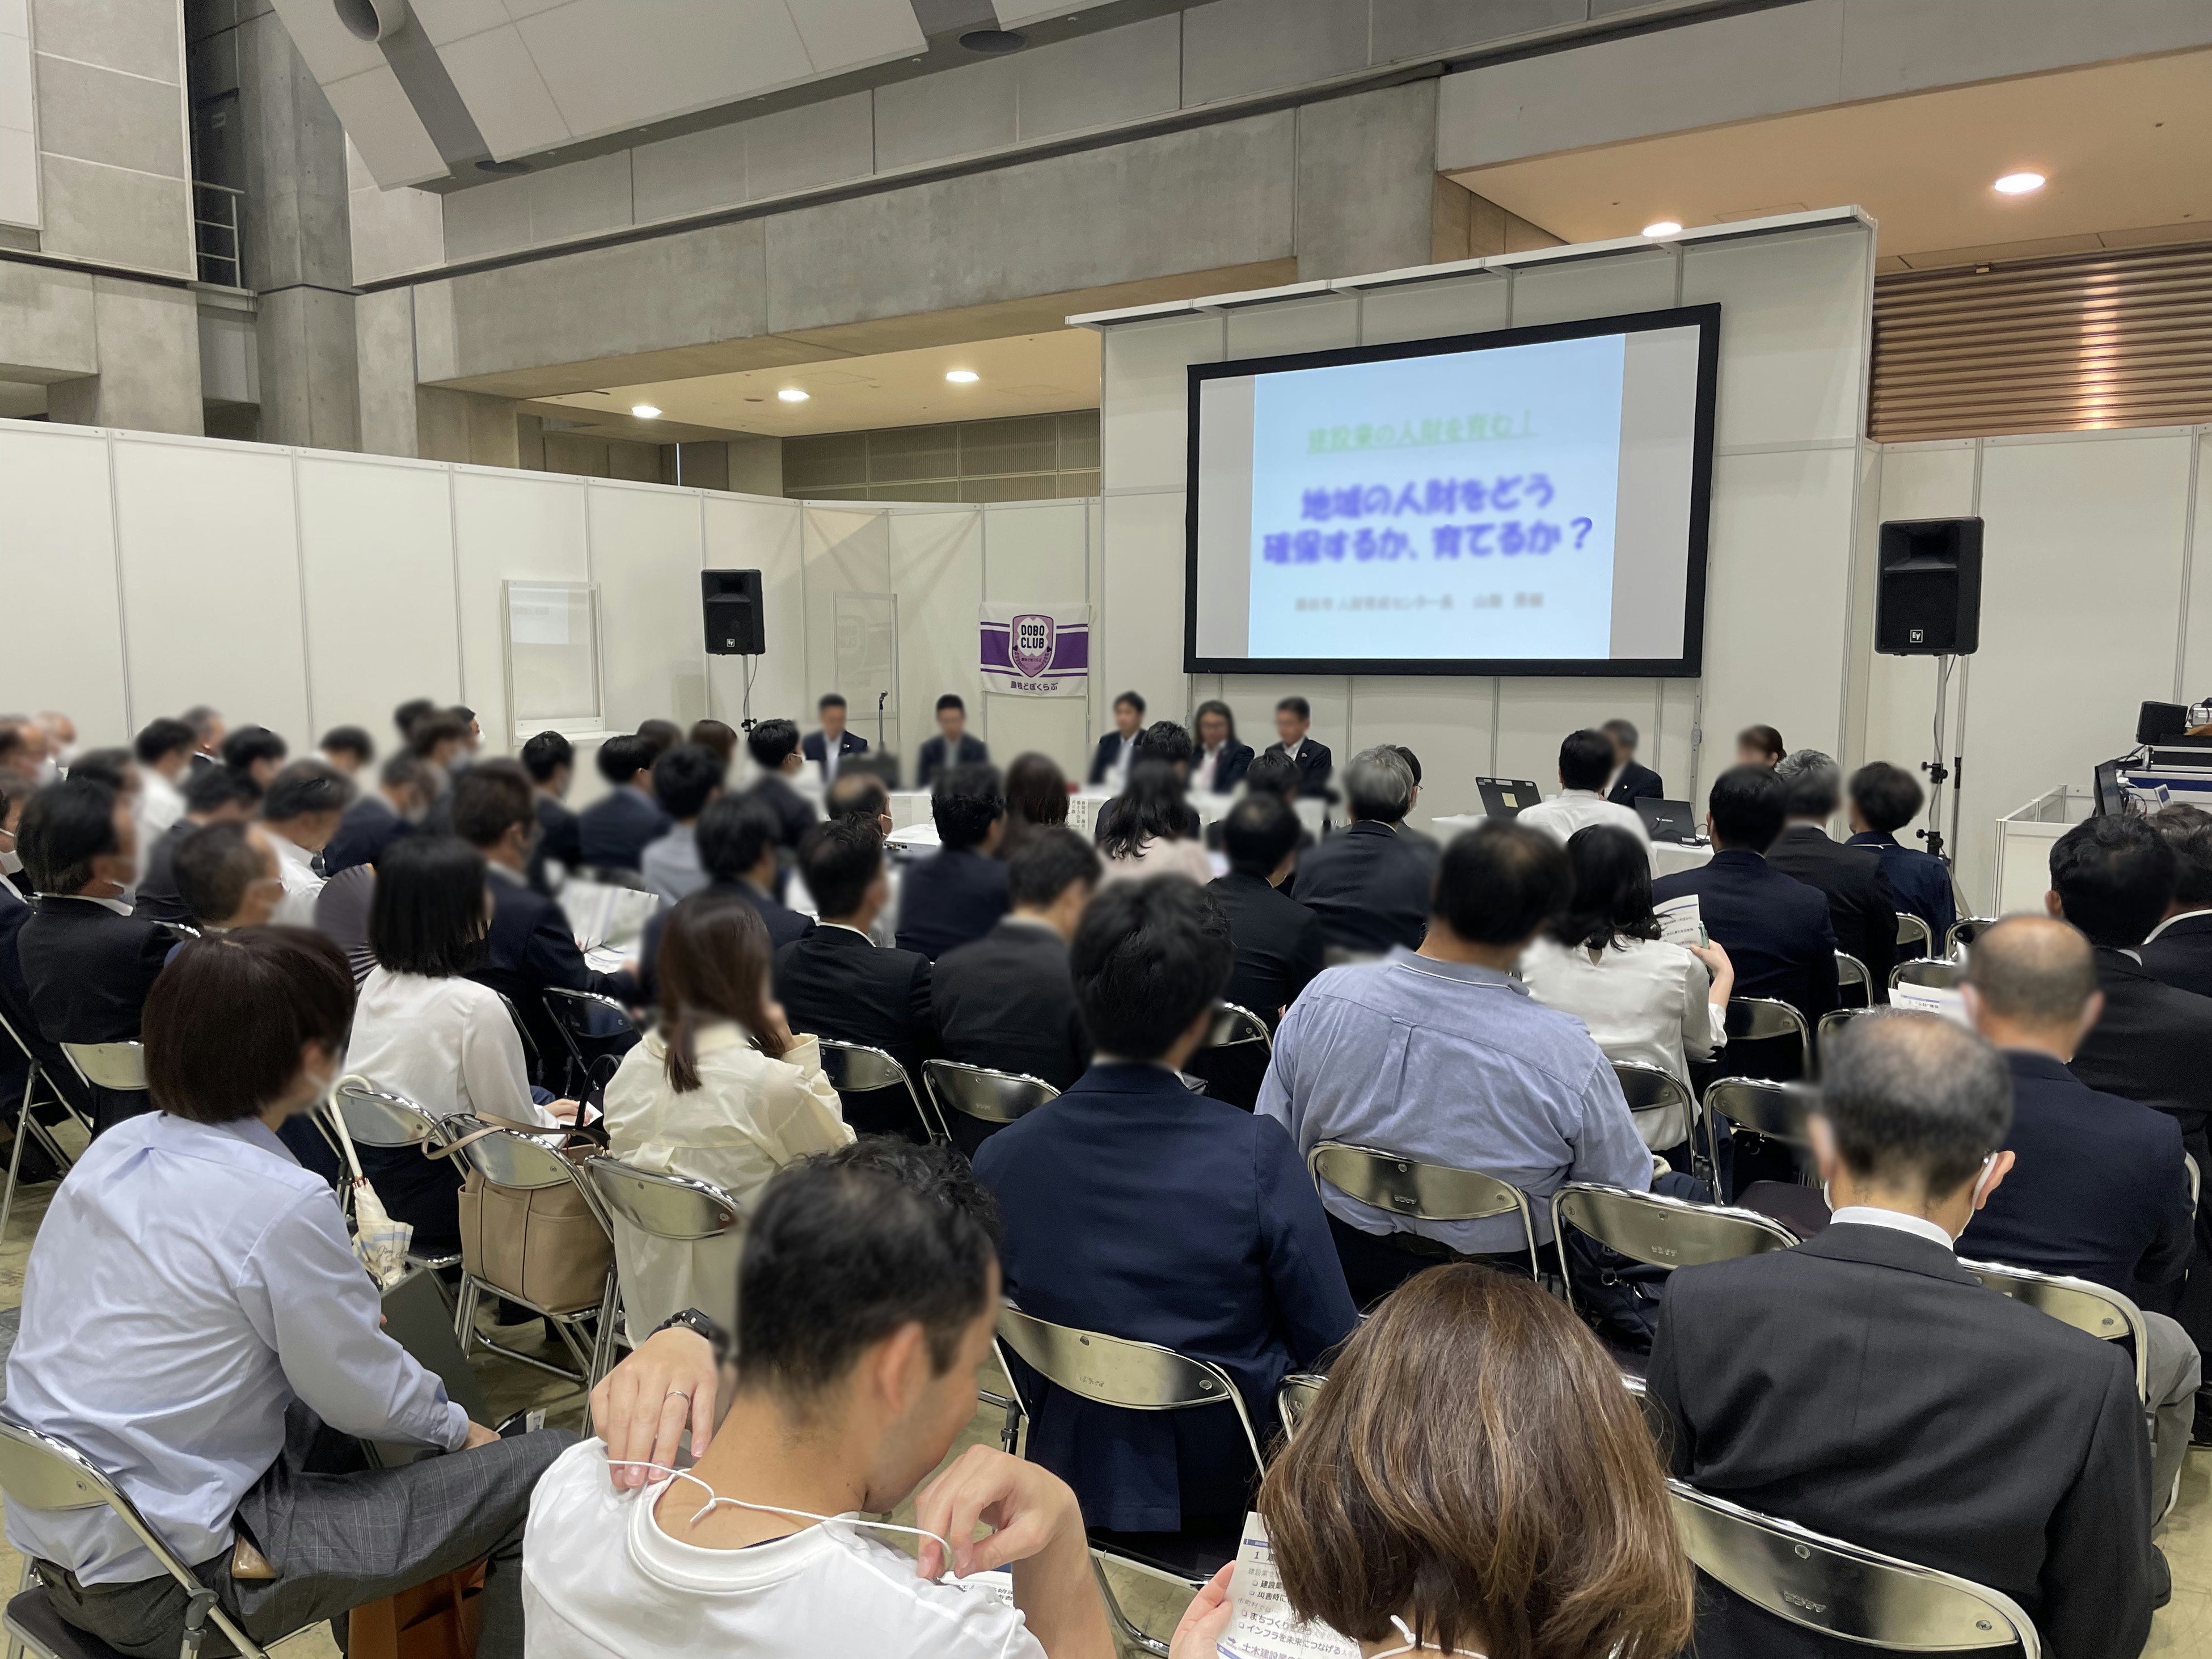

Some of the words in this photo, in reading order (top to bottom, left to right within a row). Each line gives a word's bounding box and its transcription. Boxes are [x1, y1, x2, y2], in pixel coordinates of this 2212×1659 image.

[1301, 474, 1555, 521] 地域の人財をどう
[1021, 624, 1044, 636] DOBO
[1021, 637, 1044, 648] CLUB
